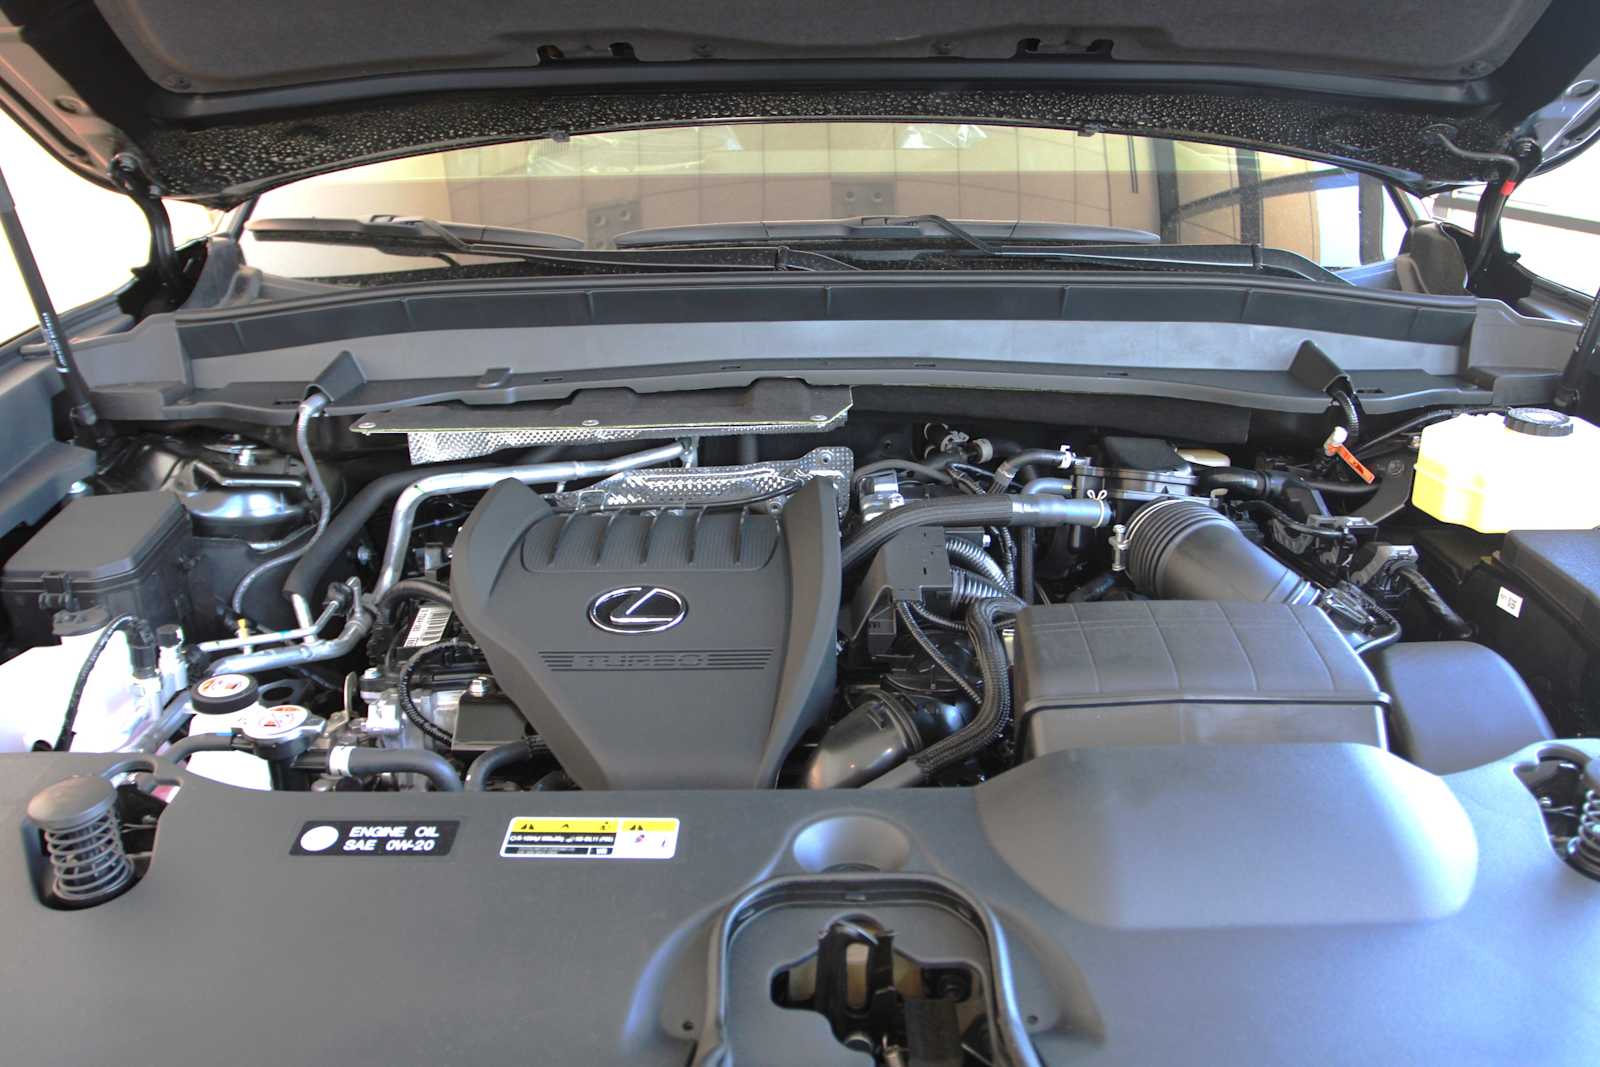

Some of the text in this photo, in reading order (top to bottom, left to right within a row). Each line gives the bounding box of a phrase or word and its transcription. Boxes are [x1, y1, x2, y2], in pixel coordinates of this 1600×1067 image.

[349, 826, 440, 838] ENGINE OIL
[343, 839, 436, 851] SAE 0W-20
